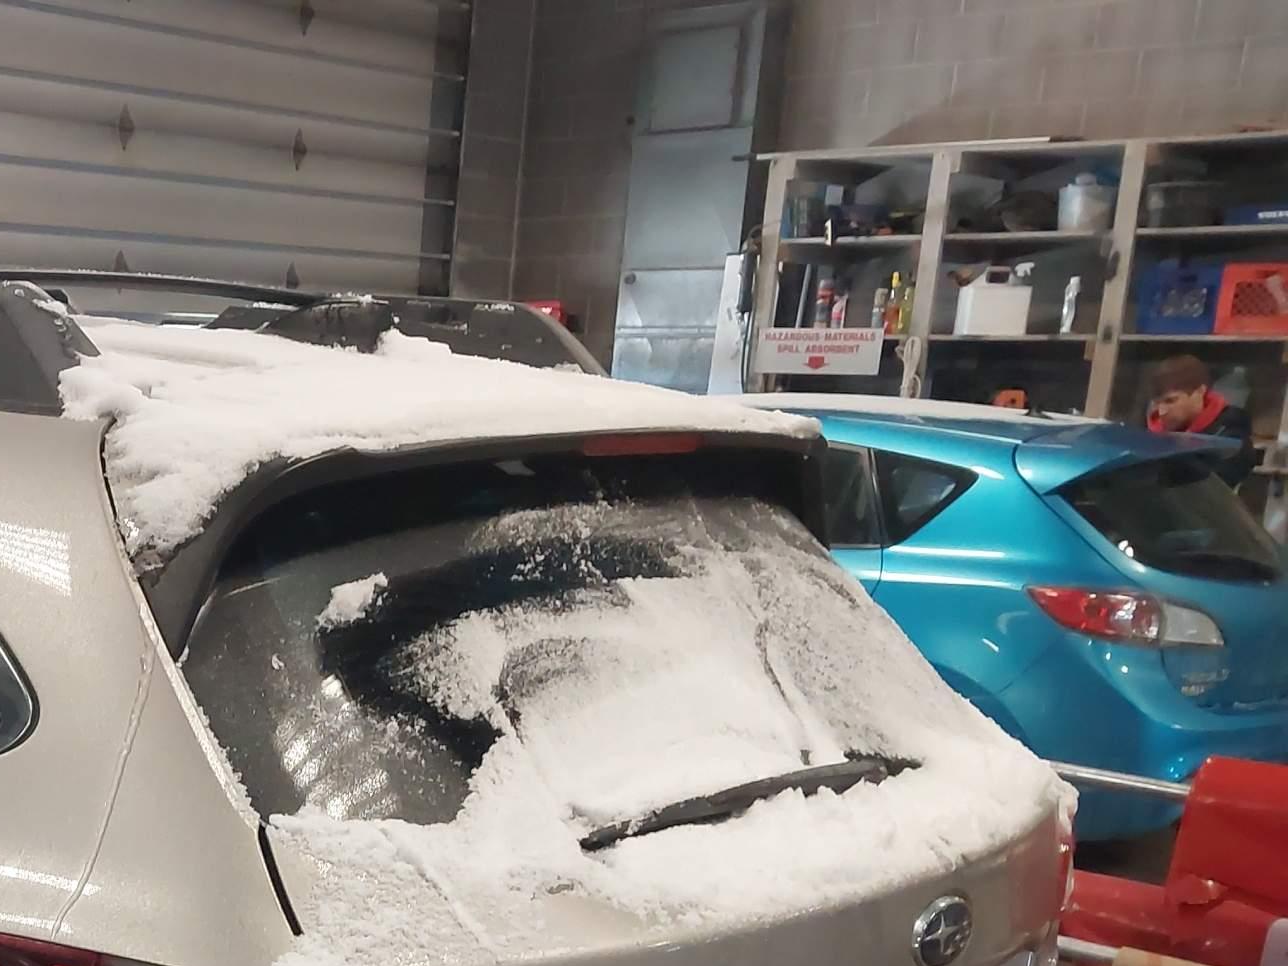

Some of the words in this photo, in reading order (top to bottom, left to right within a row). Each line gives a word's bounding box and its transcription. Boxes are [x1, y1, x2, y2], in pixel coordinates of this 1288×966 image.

[765, 332, 820, 341] HAZARDOUS
[825, 332, 876, 341] MATERIALS
[777, 344, 800, 353] SPILL
[805, 344, 860, 353] ABSORBENT
